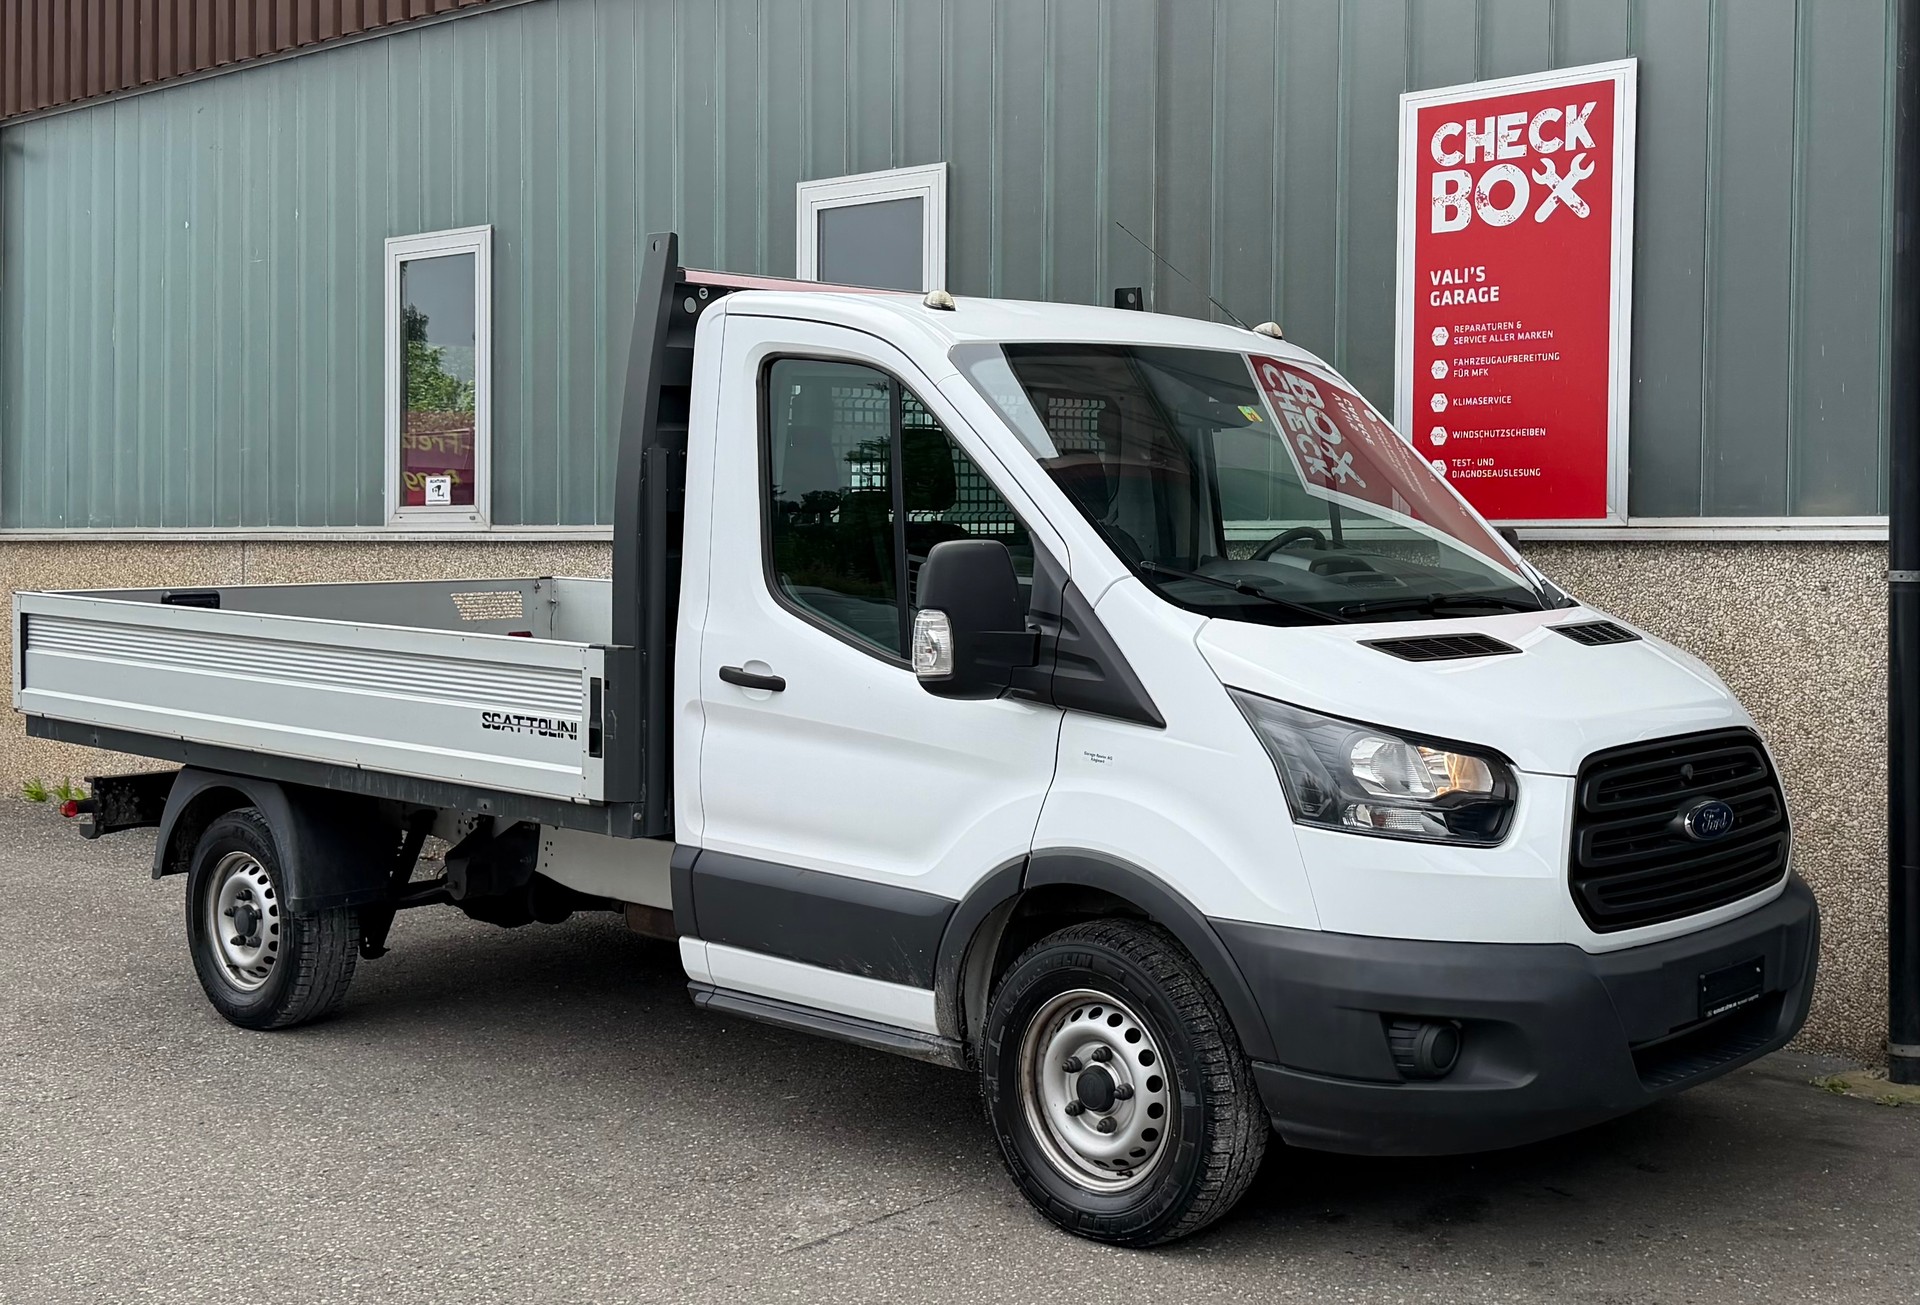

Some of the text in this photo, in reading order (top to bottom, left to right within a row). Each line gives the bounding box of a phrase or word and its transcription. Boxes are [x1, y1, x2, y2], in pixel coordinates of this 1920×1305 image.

[1430, 101, 1598, 167] CHECK
[1431, 152, 1596, 234] BOX
[1430, 266, 1486, 286] VALI'S
[1430, 286, 1500, 307] GARAGE
[1454, 320, 1522, 333] REPARATUREN &
[1453, 330, 1554, 345] SERVICE ALLER MARKEN
[1453, 352, 1560, 366] FAHRZEUGAUFBEREITUNG
[1453, 368, 1489, 378] FÜR MFK
[1453, 395, 1512, 407] KLIMASERVICE
[1452, 427, 1546, 439] WINDSCHUTZSCHEIBEN
[1452, 458, 1495, 467] TEST- UND
[1452, 468, 1541, 478] DIAGNOSEAUSLESUNG
[481, 711, 578, 741] SCATTOLINI
[1702, 808, 1728, 833] Ford
